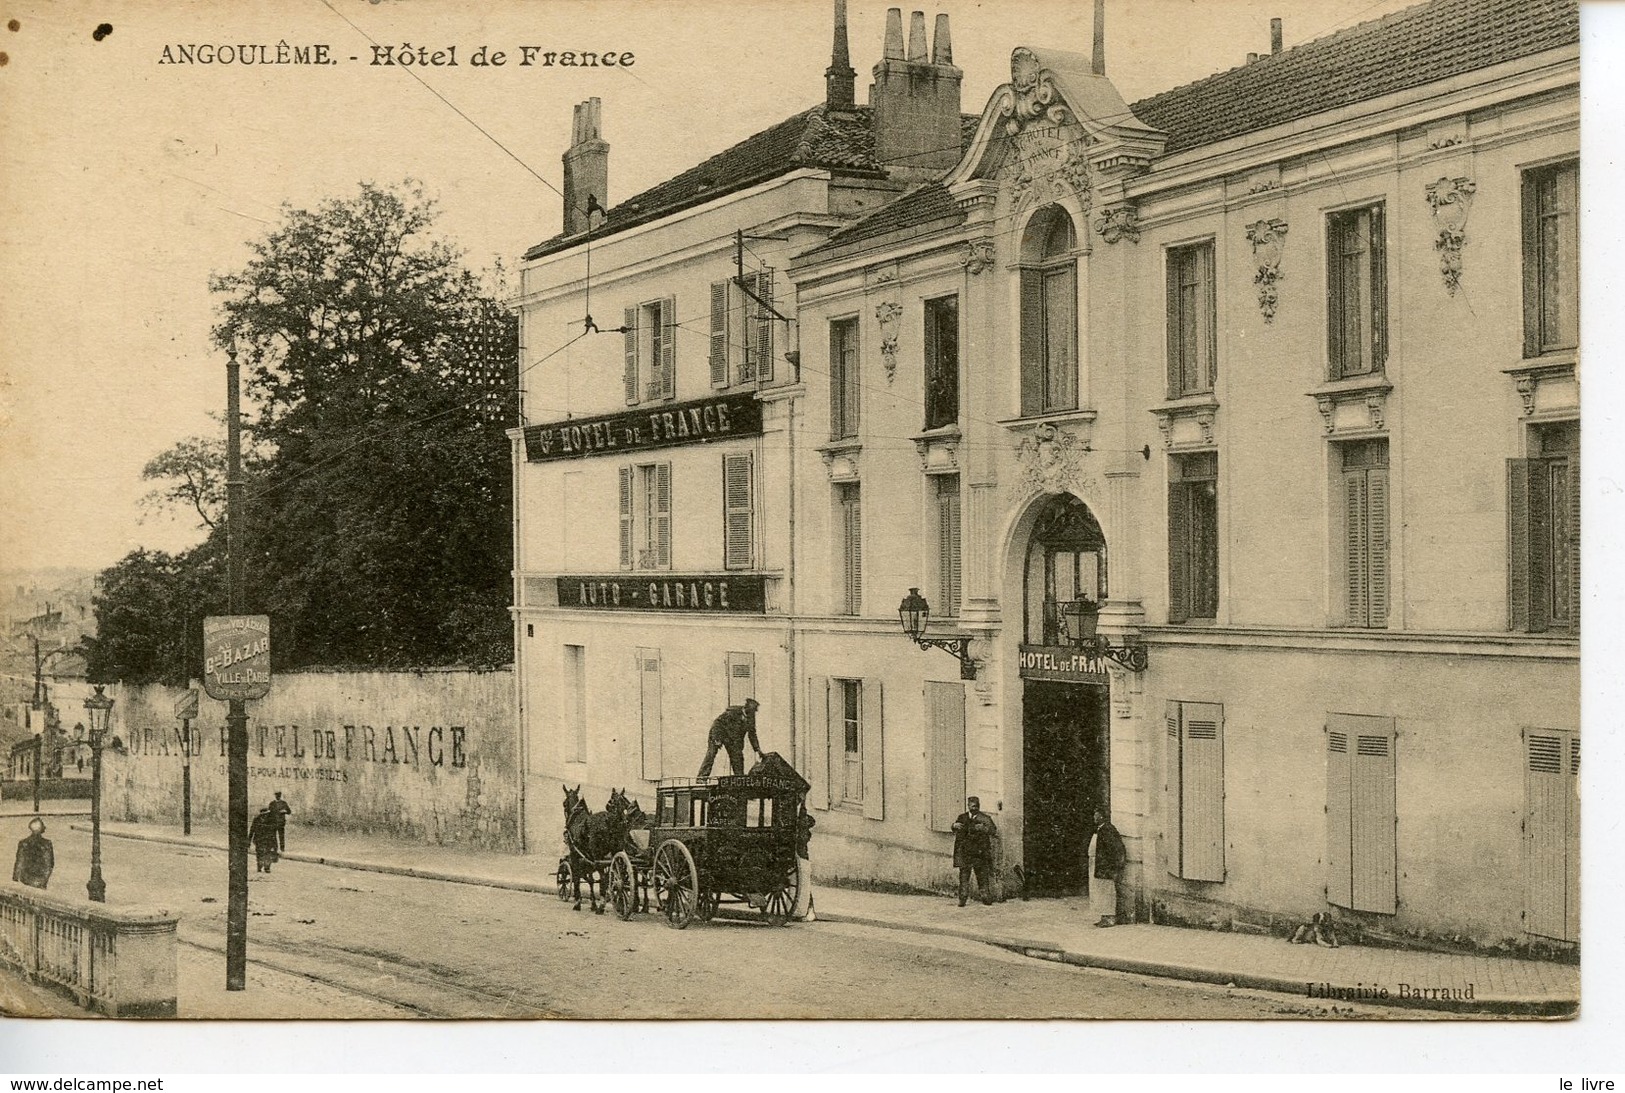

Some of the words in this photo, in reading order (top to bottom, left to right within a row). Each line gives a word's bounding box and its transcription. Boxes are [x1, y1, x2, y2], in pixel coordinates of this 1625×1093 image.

[561, 421, 617, 452] HOTEL
[626, 427, 642, 445] DE
[650, 403, 731, 441] FRANCE
[579, 582, 620, 605] AUTO
[650, 582, 729, 608] GARAGE
[222, 637, 269, 668] BAZAR
[1019, 652, 1058, 671] HOTEL
[1060, 661, 1070, 671] DE
[1071, 655, 1106, 674] FRAN
[214, 669, 240, 688] VILLE
[246, 668, 269, 688] PARIS
[219, 725, 305, 758] HTEL
[313, 729, 335, 760] DE
[343, 725, 467, 771] FRANCE
